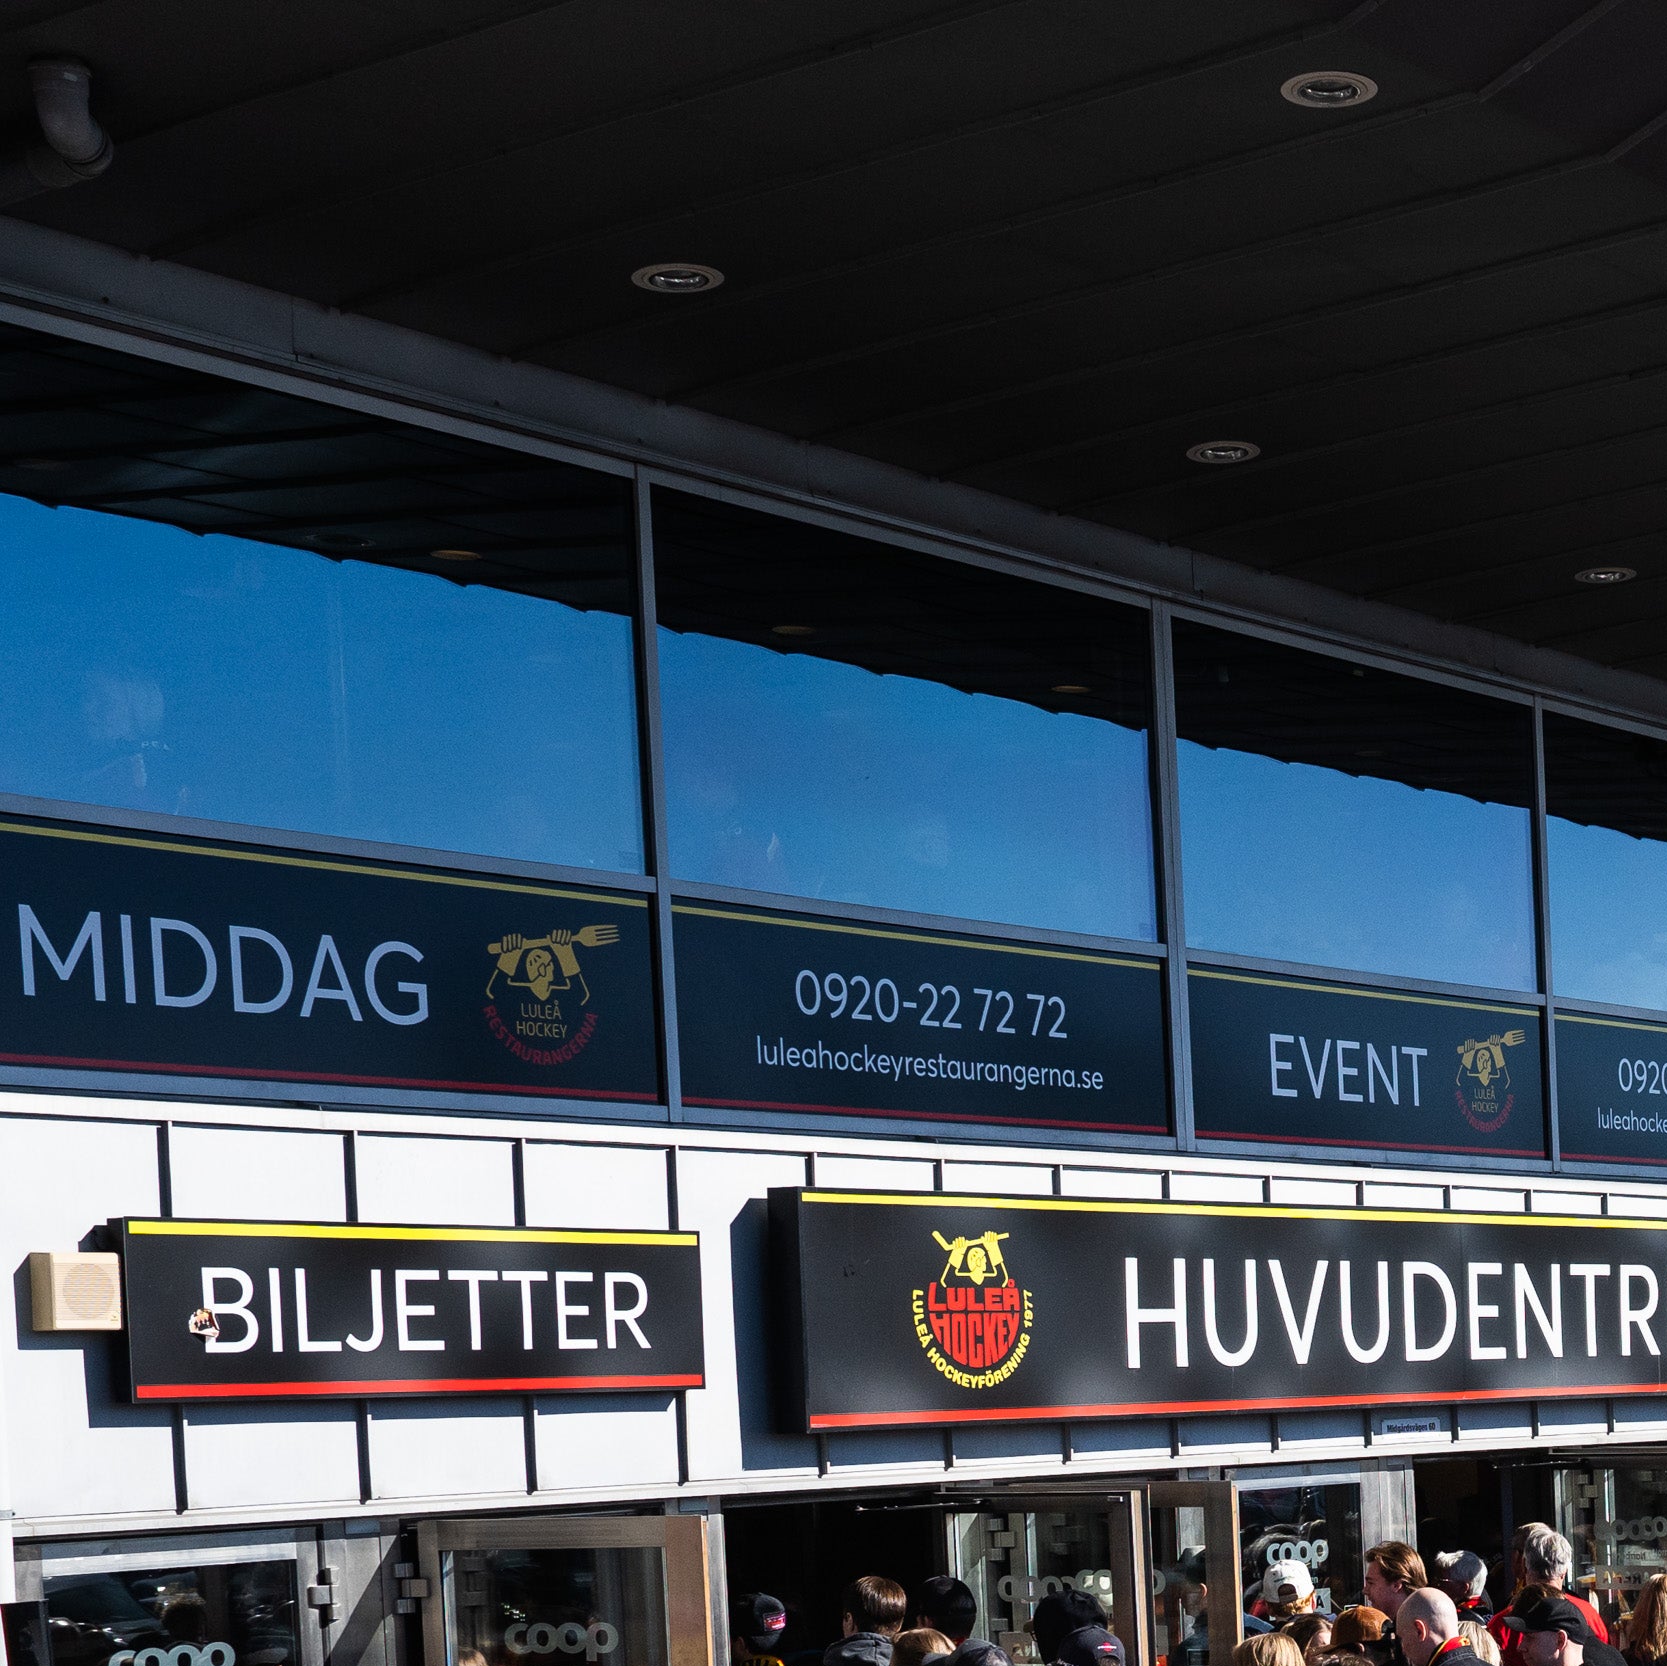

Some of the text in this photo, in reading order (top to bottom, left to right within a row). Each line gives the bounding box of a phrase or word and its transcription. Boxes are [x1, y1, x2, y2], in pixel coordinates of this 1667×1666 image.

[19, 904, 429, 1026] MIDDAG
[516, 1020, 568, 1039] HOCKEY
[520, 1000, 562, 1020] LULEÅ
[795, 969, 1068, 1040] 0920-22 72 72
[757, 1035, 1105, 1091] luleahockeyrestaurangerna.se
[1269, 1033, 1428, 1107] EVENT
[200, 1265, 652, 1354] BILJETTER
[928, 1278, 1020, 1311] LULEÅ
[927, 1332, 1030, 1389] HOCKEYFÖRENING
[929, 1312, 1020, 1368] HOCKEY
[504, 1622, 619, 1662] coop
